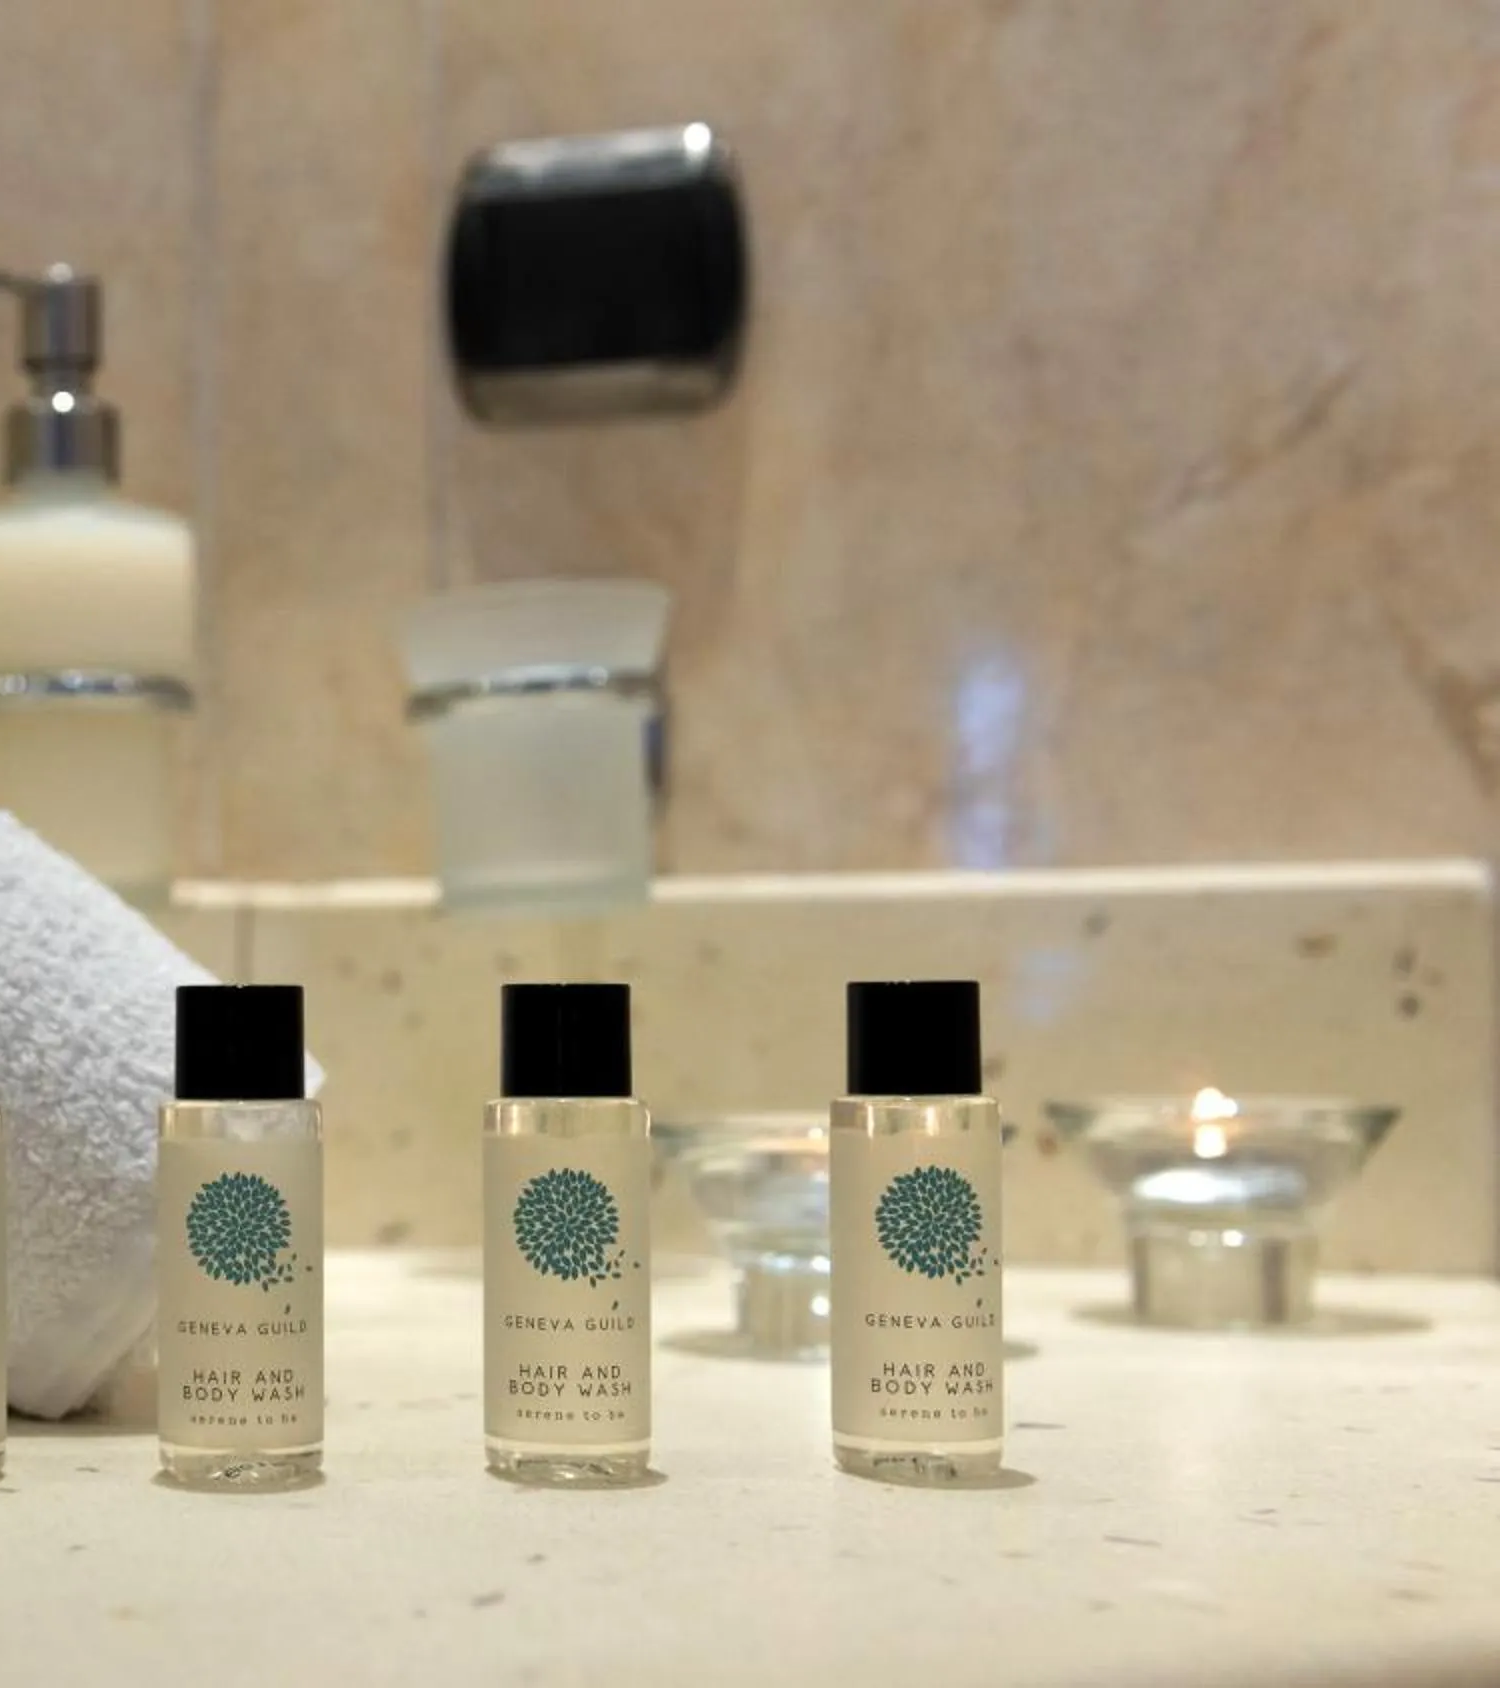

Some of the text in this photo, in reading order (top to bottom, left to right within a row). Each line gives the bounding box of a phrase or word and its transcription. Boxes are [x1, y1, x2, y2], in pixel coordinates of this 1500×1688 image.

[177, 1320, 307, 1336] GENEVA GUILD
[504, 1315, 635, 1332] GENEVA GUILD
[865, 1314, 942, 1329] GENEVA
[193, 1369, 294, 1385] HAIR AND
[518, 1363, 621, 1379] HAIR AND
[883, 1362, 985, 1377] HAIR AND
[182, 1385, 305, 1403] BODY WASH
[508, 1379, 632, 1397] BODY WASH
[871, 1377, 993, 1395] BODY WASH
[950, 1408, 967, 1419] to
